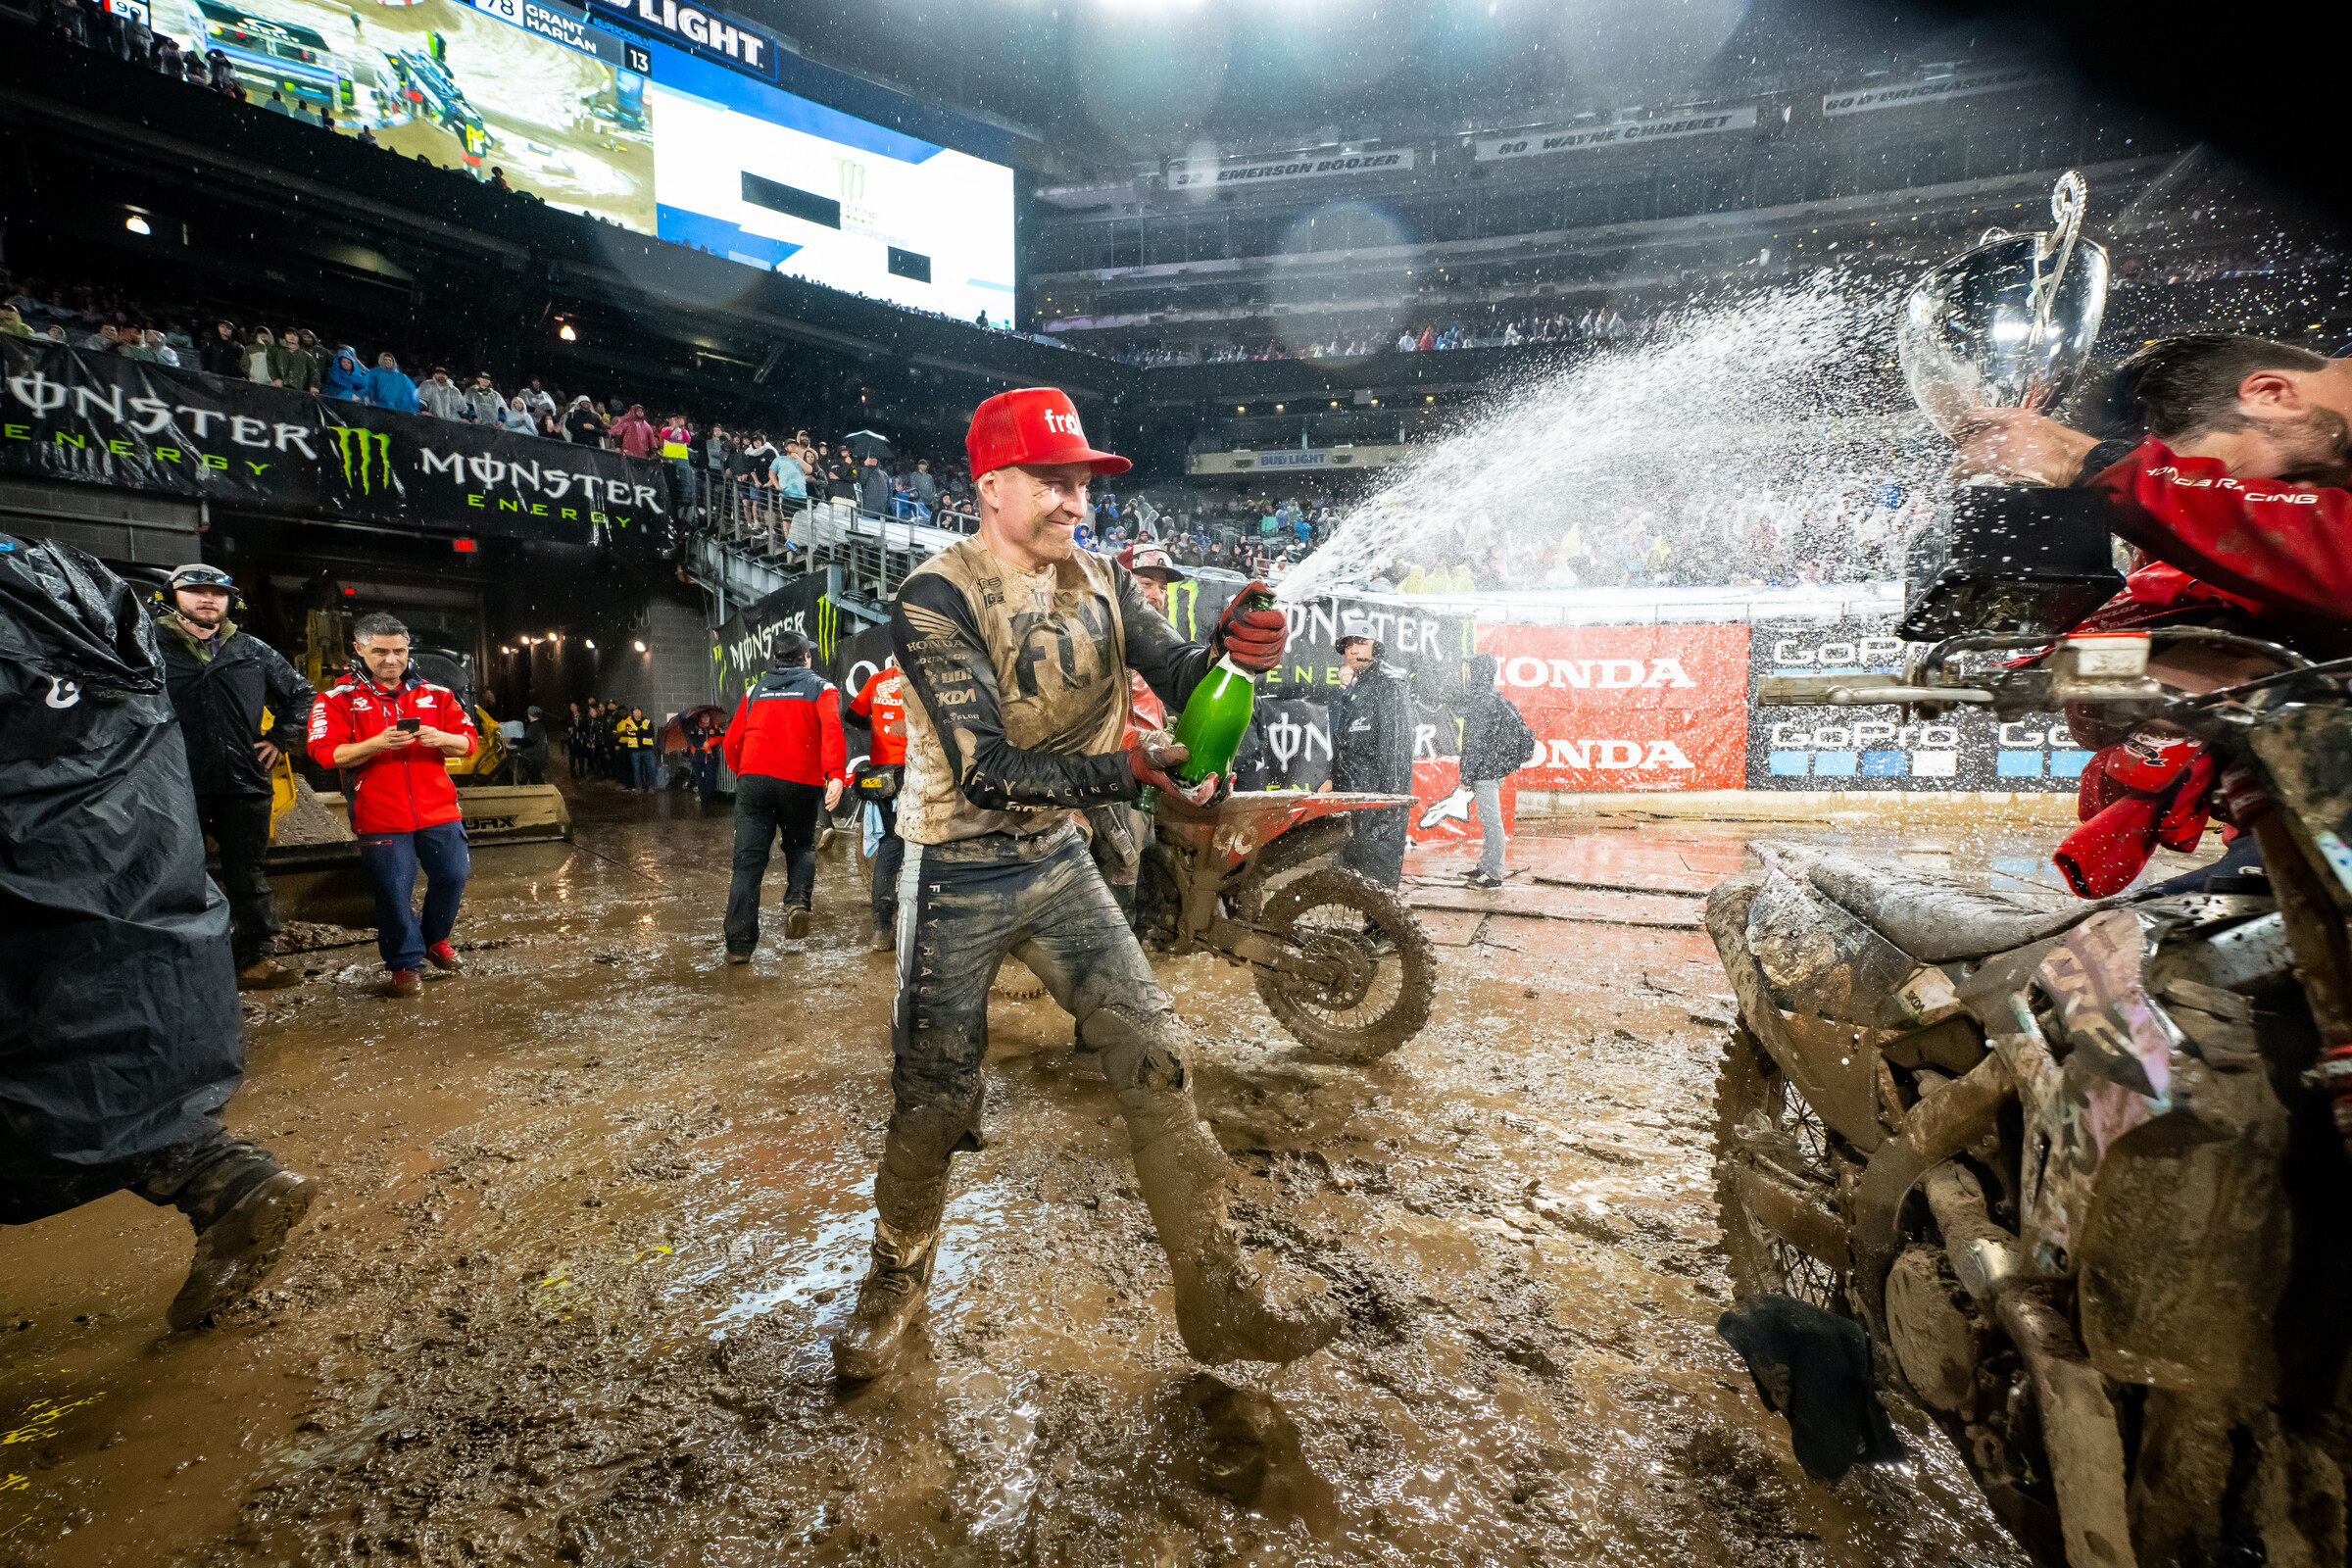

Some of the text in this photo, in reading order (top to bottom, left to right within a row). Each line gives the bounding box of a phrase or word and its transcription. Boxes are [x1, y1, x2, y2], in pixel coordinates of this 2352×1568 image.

[488, 0, 514, 16] 8
[525, 4, 585, 36] GRANT
[526, 16, 597, 54] HARLAN
[593, 17, 653, 48] #SUPERCROSSLIV
[639, 0, 763, 68] LIGHT
[629, 49, 649, 73] 13
[1542, 129, 1620, 150] WAYNE
[1177, 154, 1401, 185] 32 EMERSON BOOZER
[4, 422, 273, 476] ENERGY
[1260, 453, 1327, 466] BUD LIGHT
[419, 447, 664, 514] MONSTER
[467, 493, 631, 528] ENERGY
[457, 540, 472, 551] EXIT
[1283, 598, 1444, 661] ONSTER
[906, 639, 967, 653] HONDA
[1772, 721, 1958, 747] GoPro
[927, 884, 941, 929] FLY
